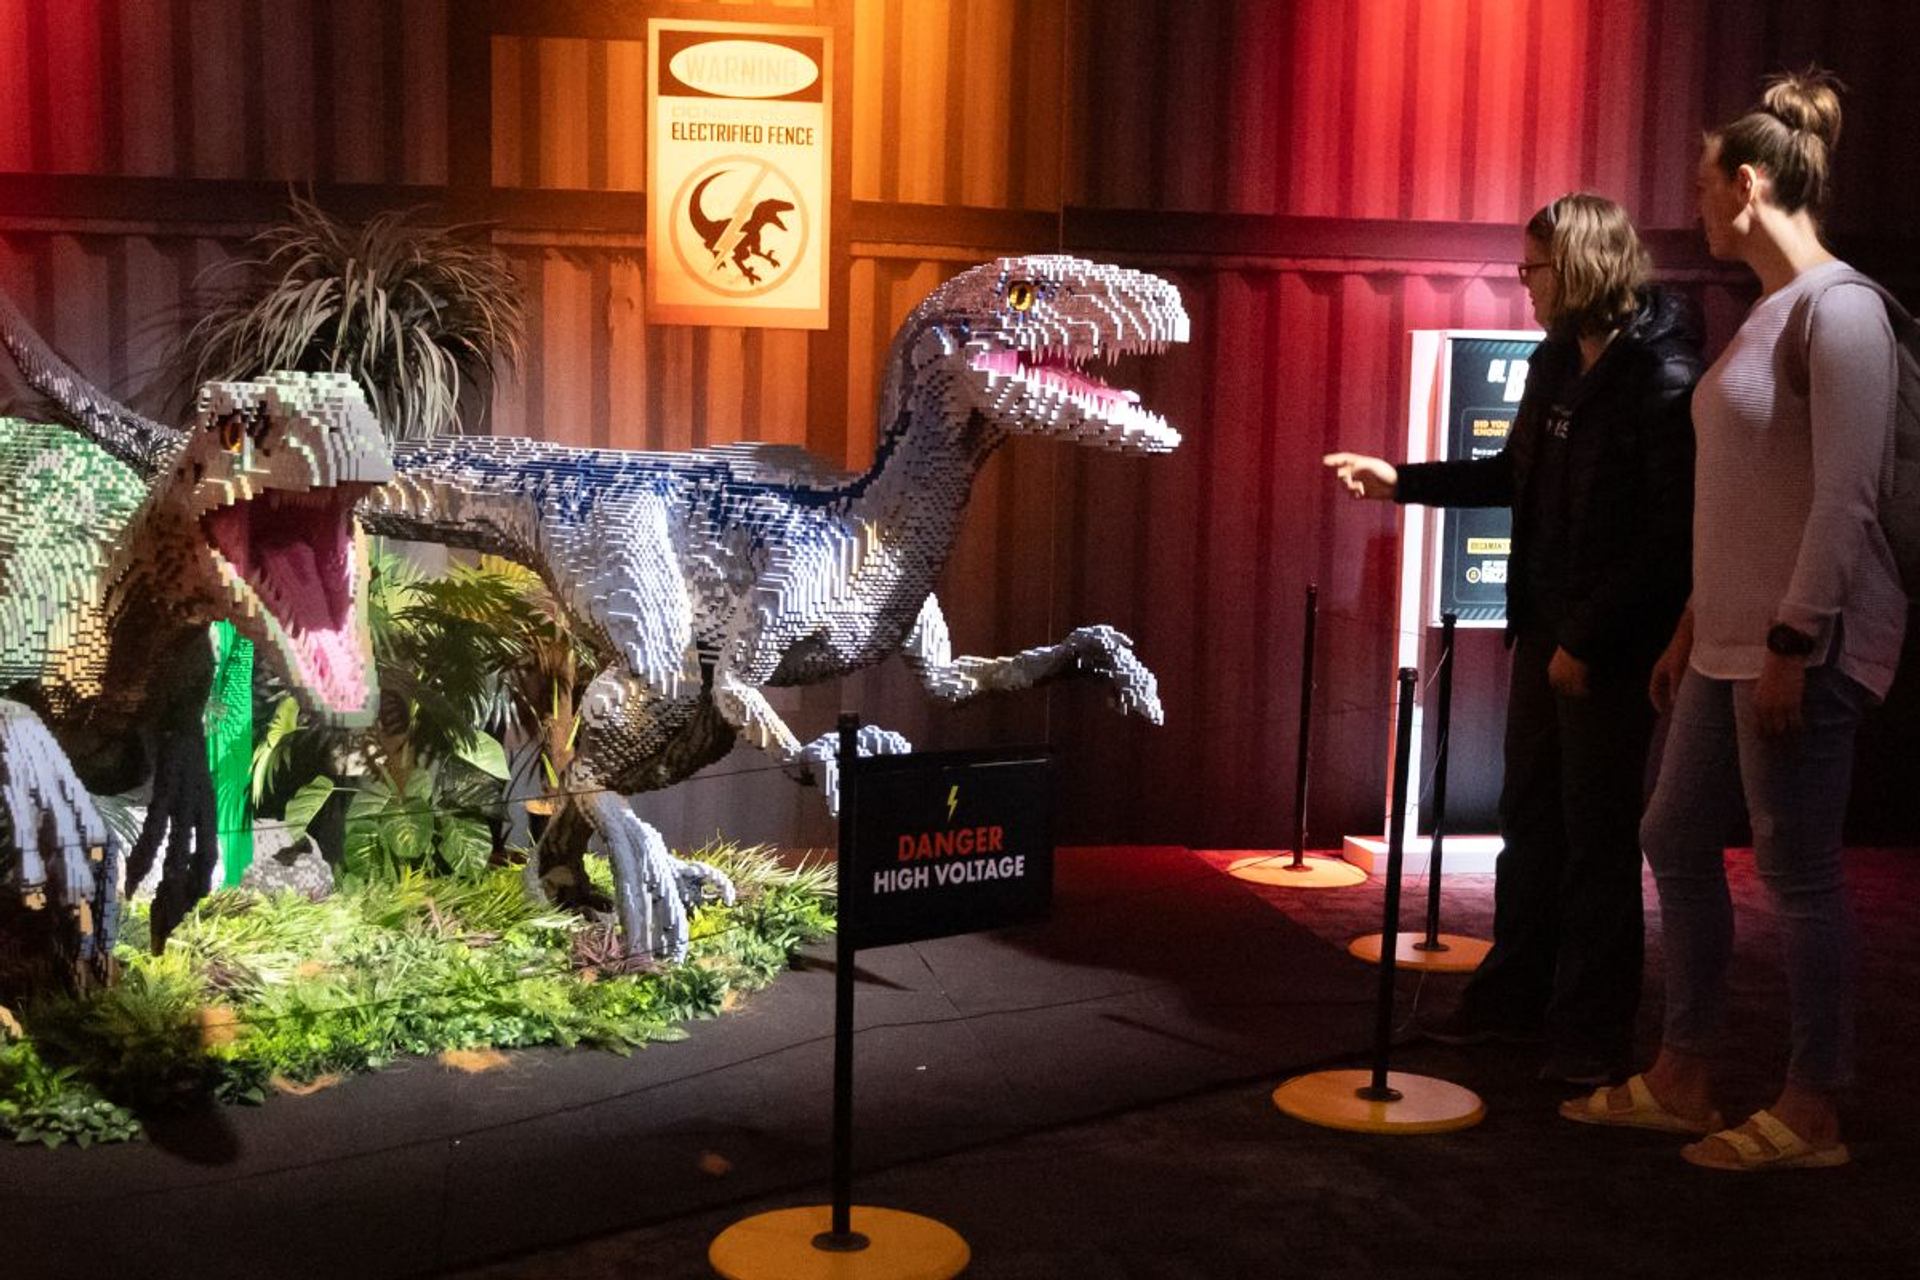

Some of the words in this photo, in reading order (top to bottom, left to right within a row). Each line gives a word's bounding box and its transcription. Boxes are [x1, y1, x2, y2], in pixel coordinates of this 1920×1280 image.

[686, 54, 798, 86] WARNING
[671, 121, 763, 144] ELECTRIFIED
[768, 125, 814, 146] FENCE
[898, 826, 1004, 861] DANGER
[873, 866, 930, 894] HIGH
[934, 855, 1025, 885] VOLTAGE
